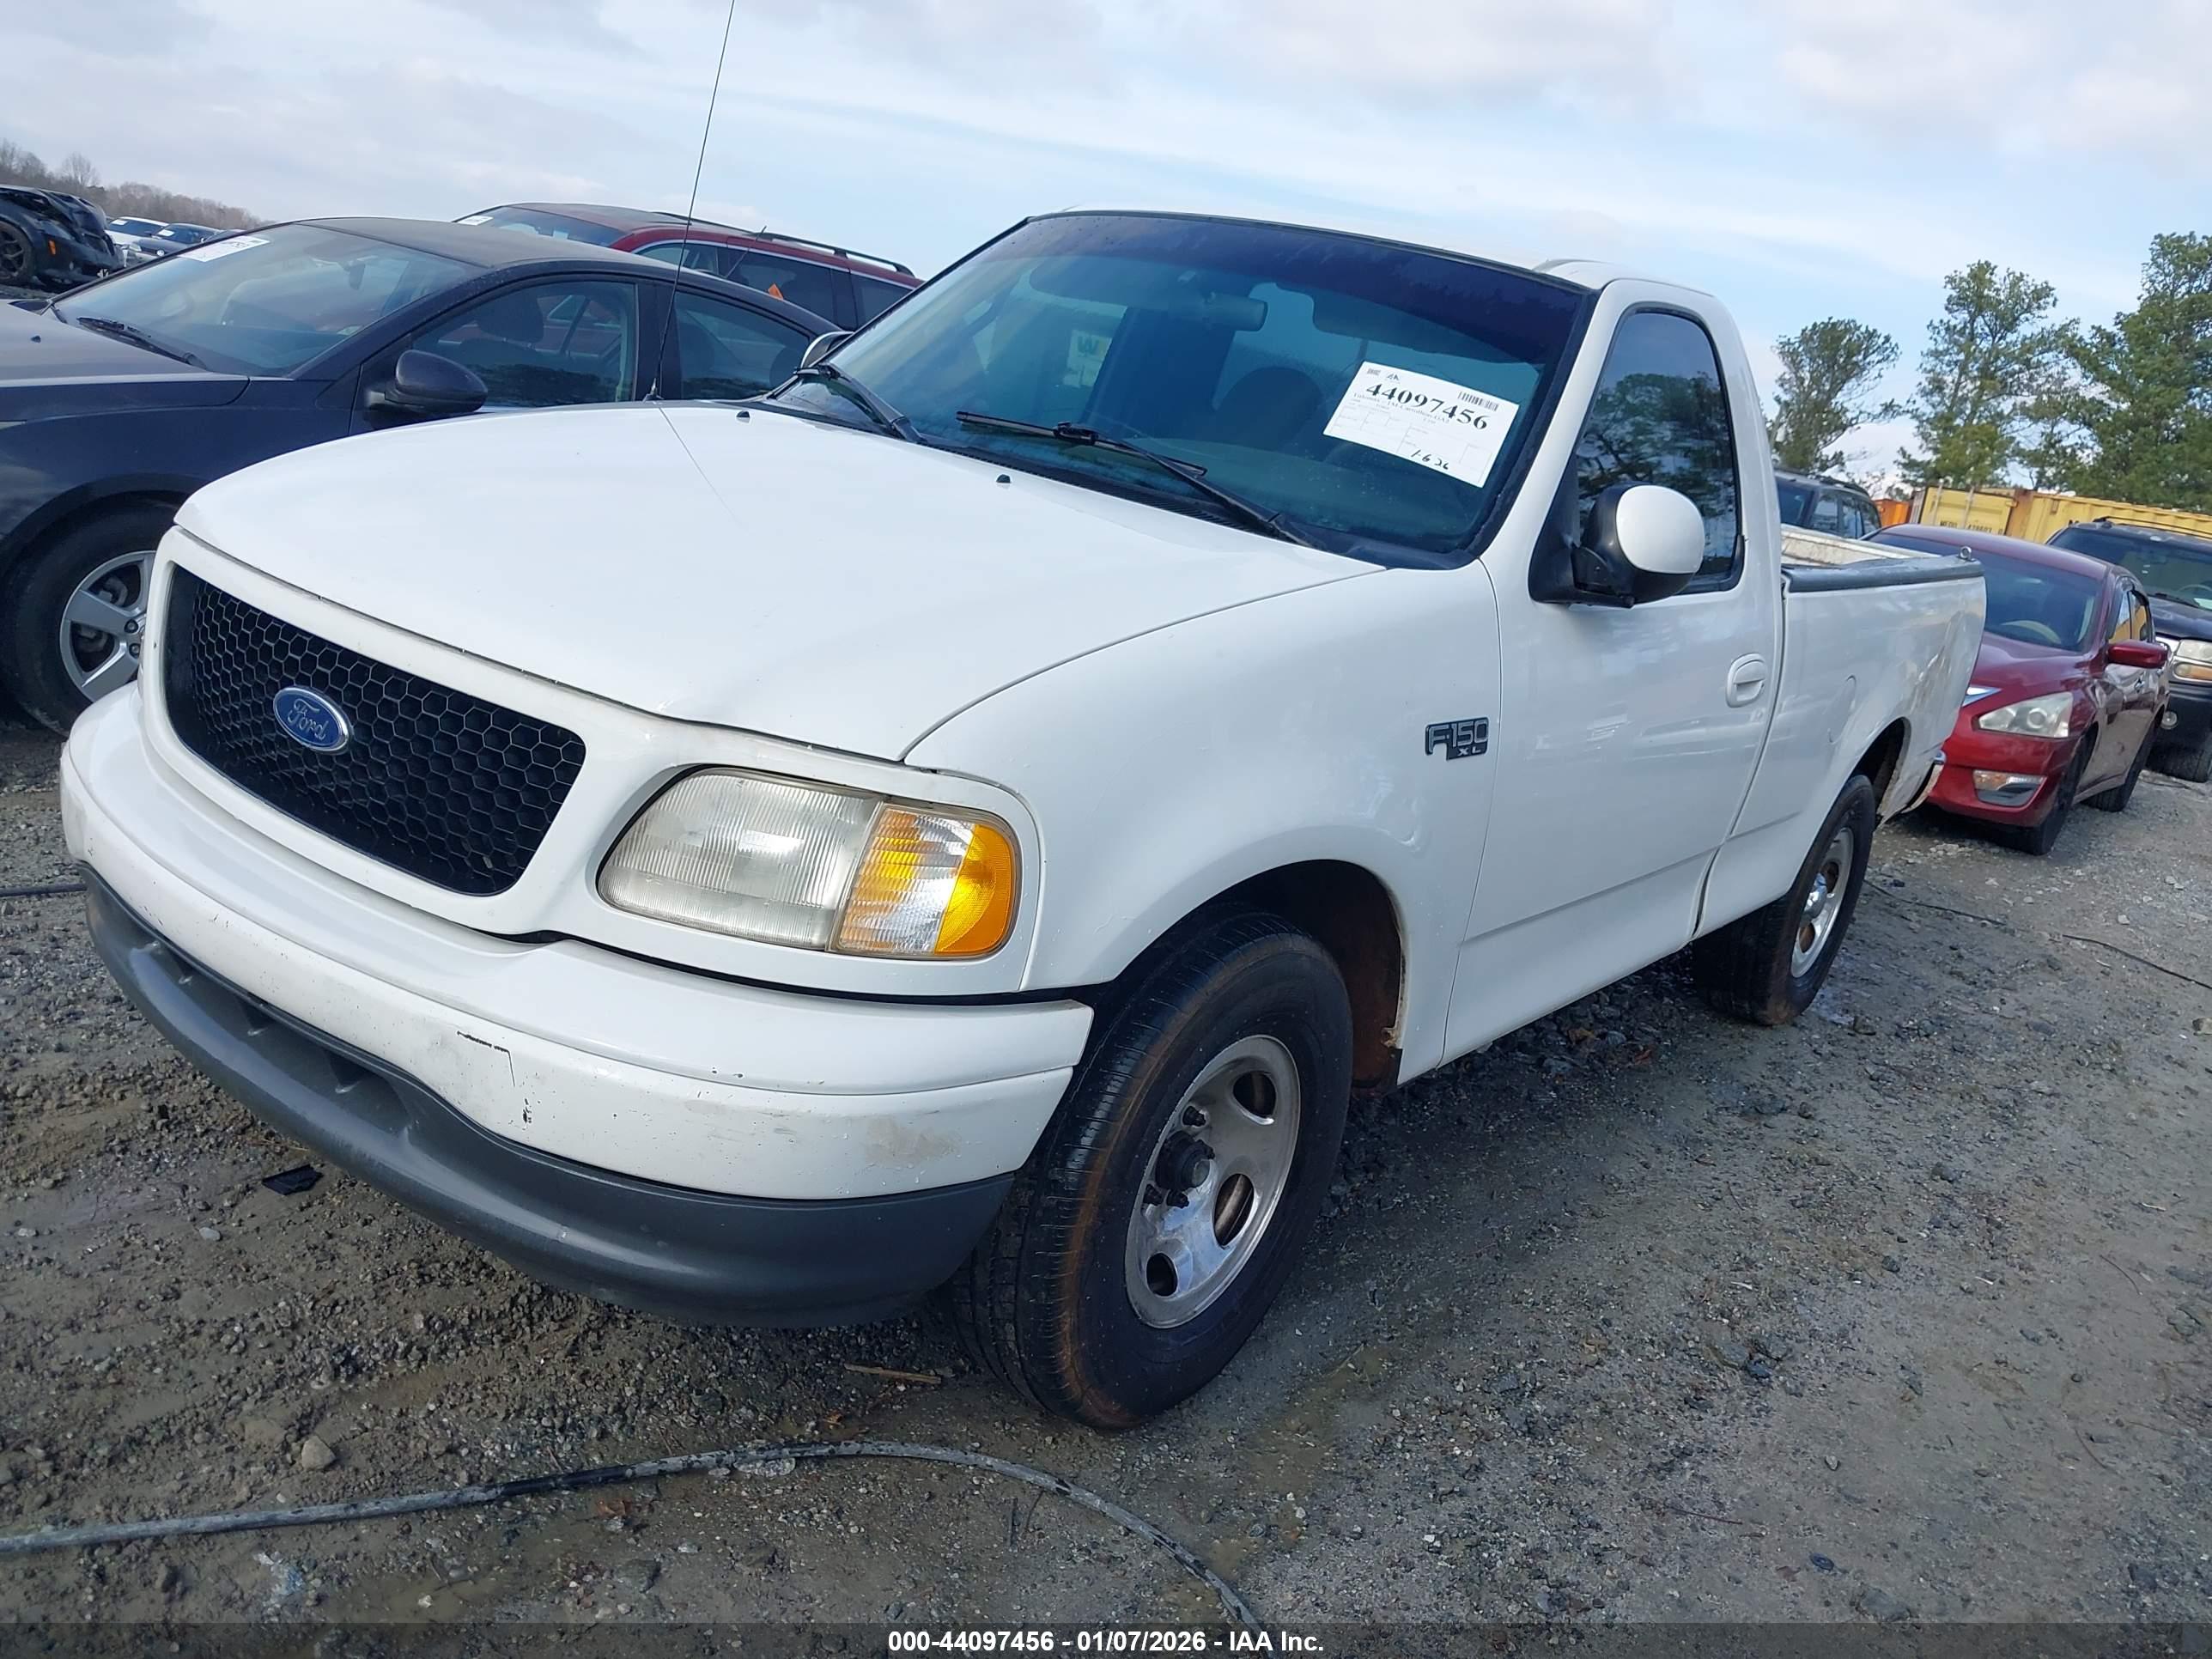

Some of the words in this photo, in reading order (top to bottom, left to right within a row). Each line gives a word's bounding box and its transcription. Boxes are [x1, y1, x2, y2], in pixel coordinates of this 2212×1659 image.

[1366, 384, 1490, 429] 44097456
[288, 698, 329, 740] Ford
[1457, 746, 1481, 756] XL
